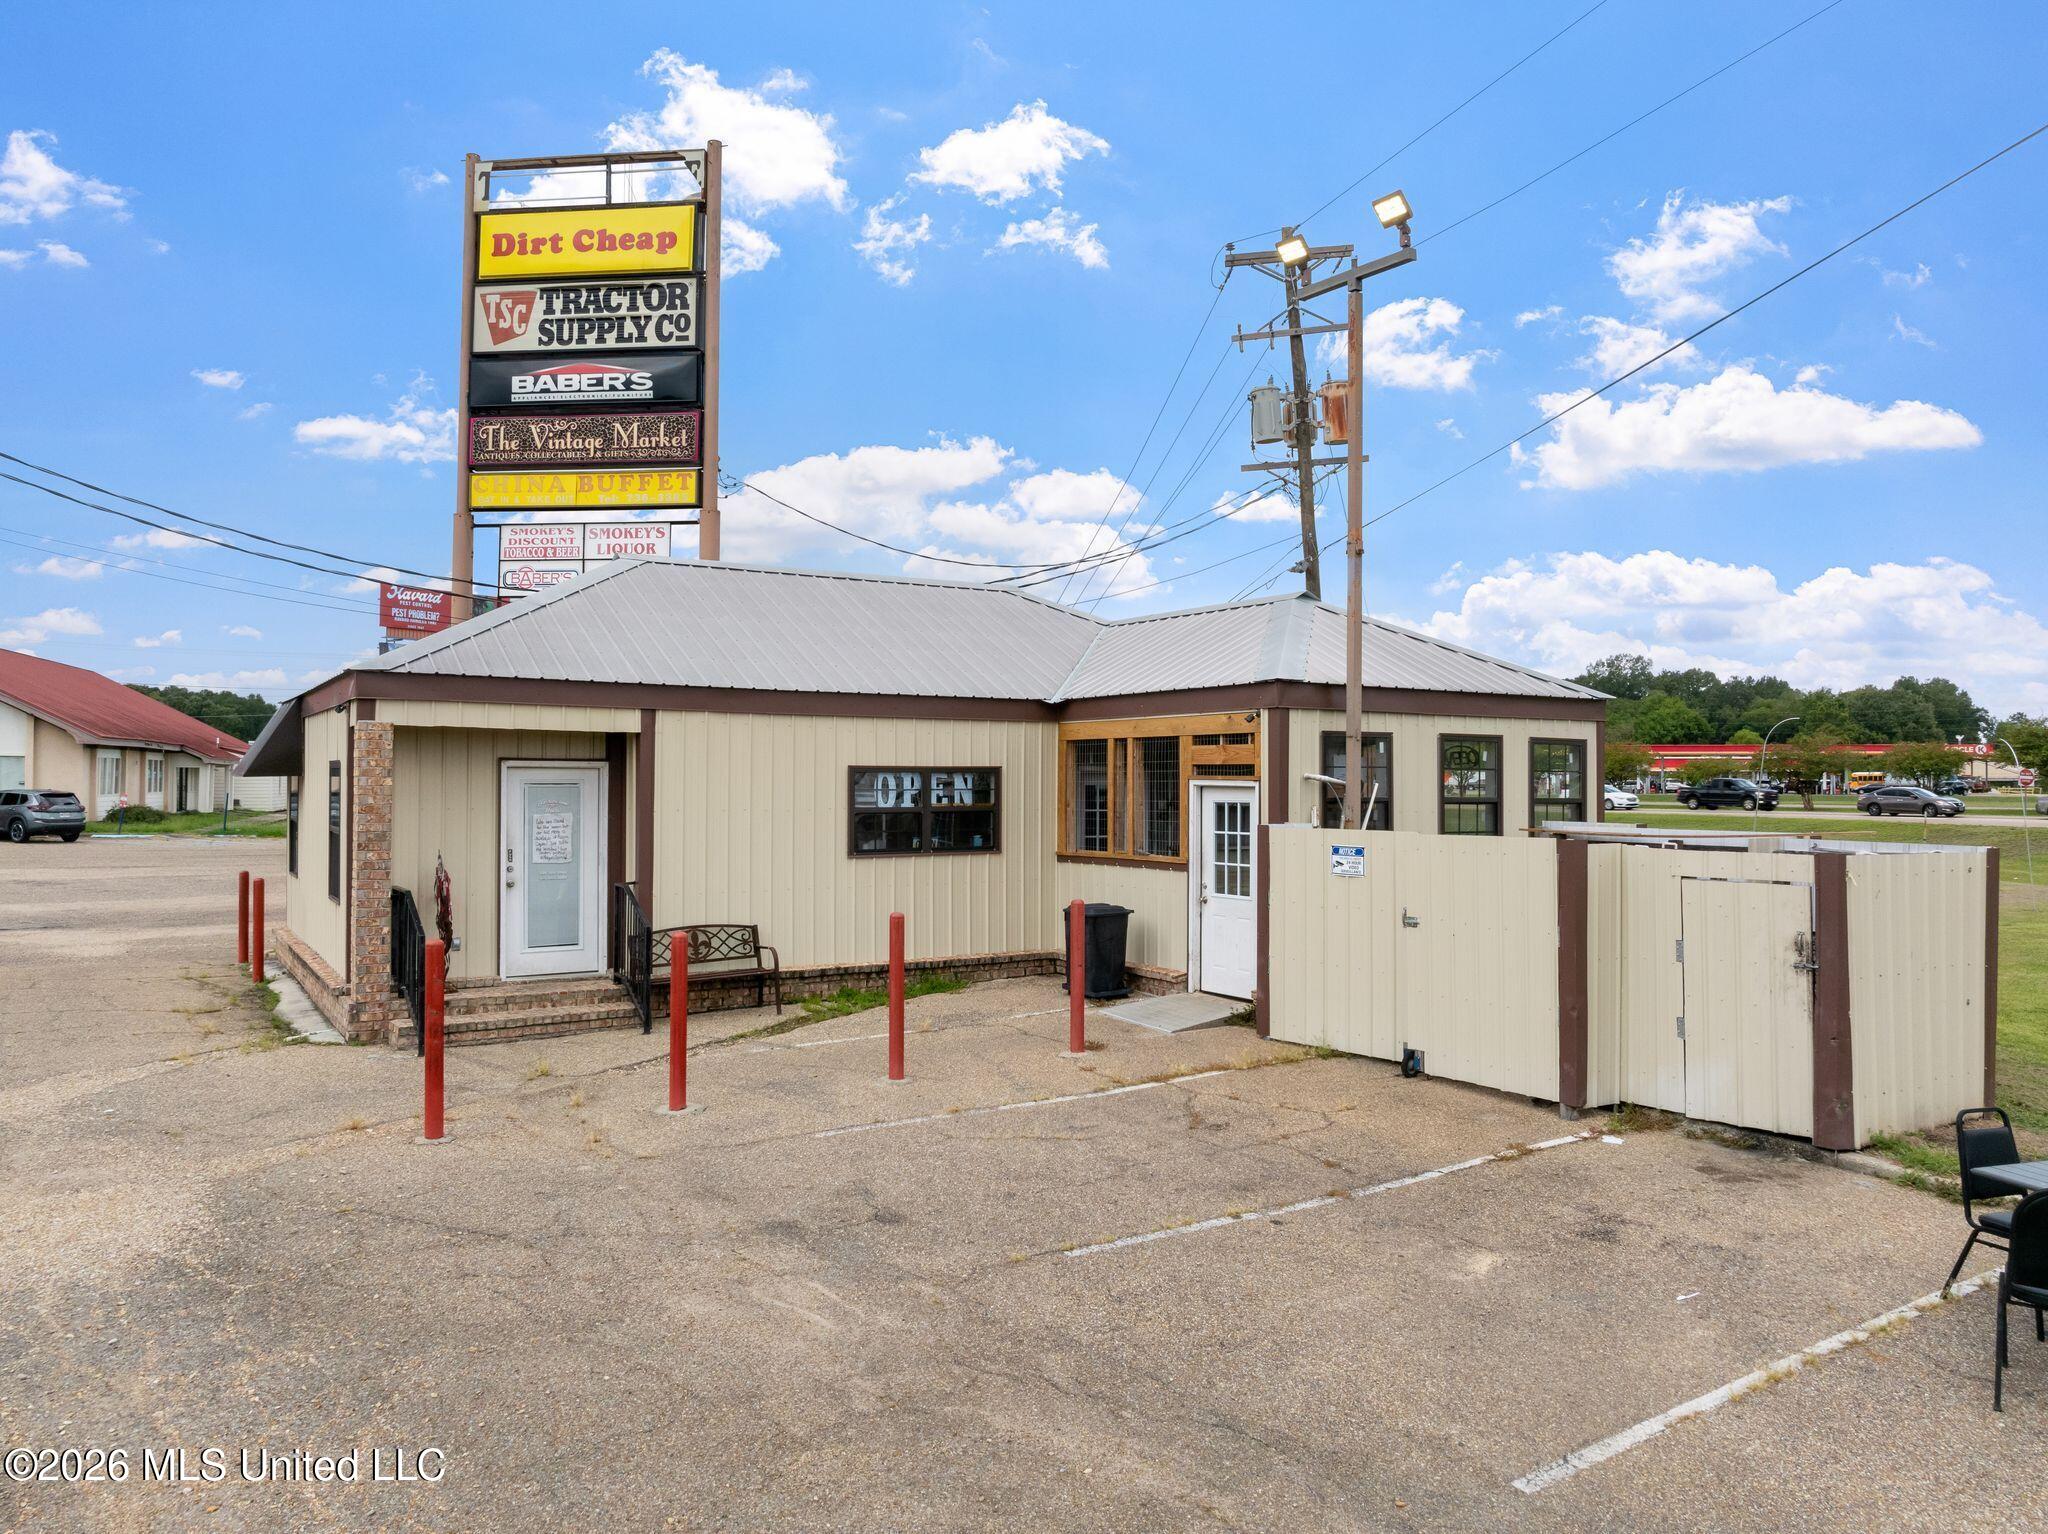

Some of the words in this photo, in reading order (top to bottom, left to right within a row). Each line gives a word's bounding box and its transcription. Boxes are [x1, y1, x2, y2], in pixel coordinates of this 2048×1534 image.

[491, 233, 563, 257] Dirt
[572, 229, 678, 255] Cheap
[539, 282, 690, 316] TRACTOR
[486, 294, 527, 335] TSC
[538, 316, 652, 346] SUPPLY
[511, 372, 653, 393] BABER'S
[480, 423, 520, 452] The
[529, 420, 604, 458] Vintage
[611, 422, 688, 449] Market
[473, 475, 567, 493] CHINA
[577, 473, 693, 493] BUFFET
[508, 537, 577, 546] DISCOUNT
[510, 527, 575, 536] SMOKEY'S
[588, 526, 666, 540] SMOKEY'S
[504, 547, 545, 558] TOBACCO
[546, 547, 555, 558] &
[556, 546, 580, 557] BEER
[597, 542, 656, 556] LIQUOR
[386, 585, 444, 604] Havard
[391, 607, 407, 617] PEST
[408, 608, 440, 621] PROBLEM?
[875, 772, 974, 808] OPEN
